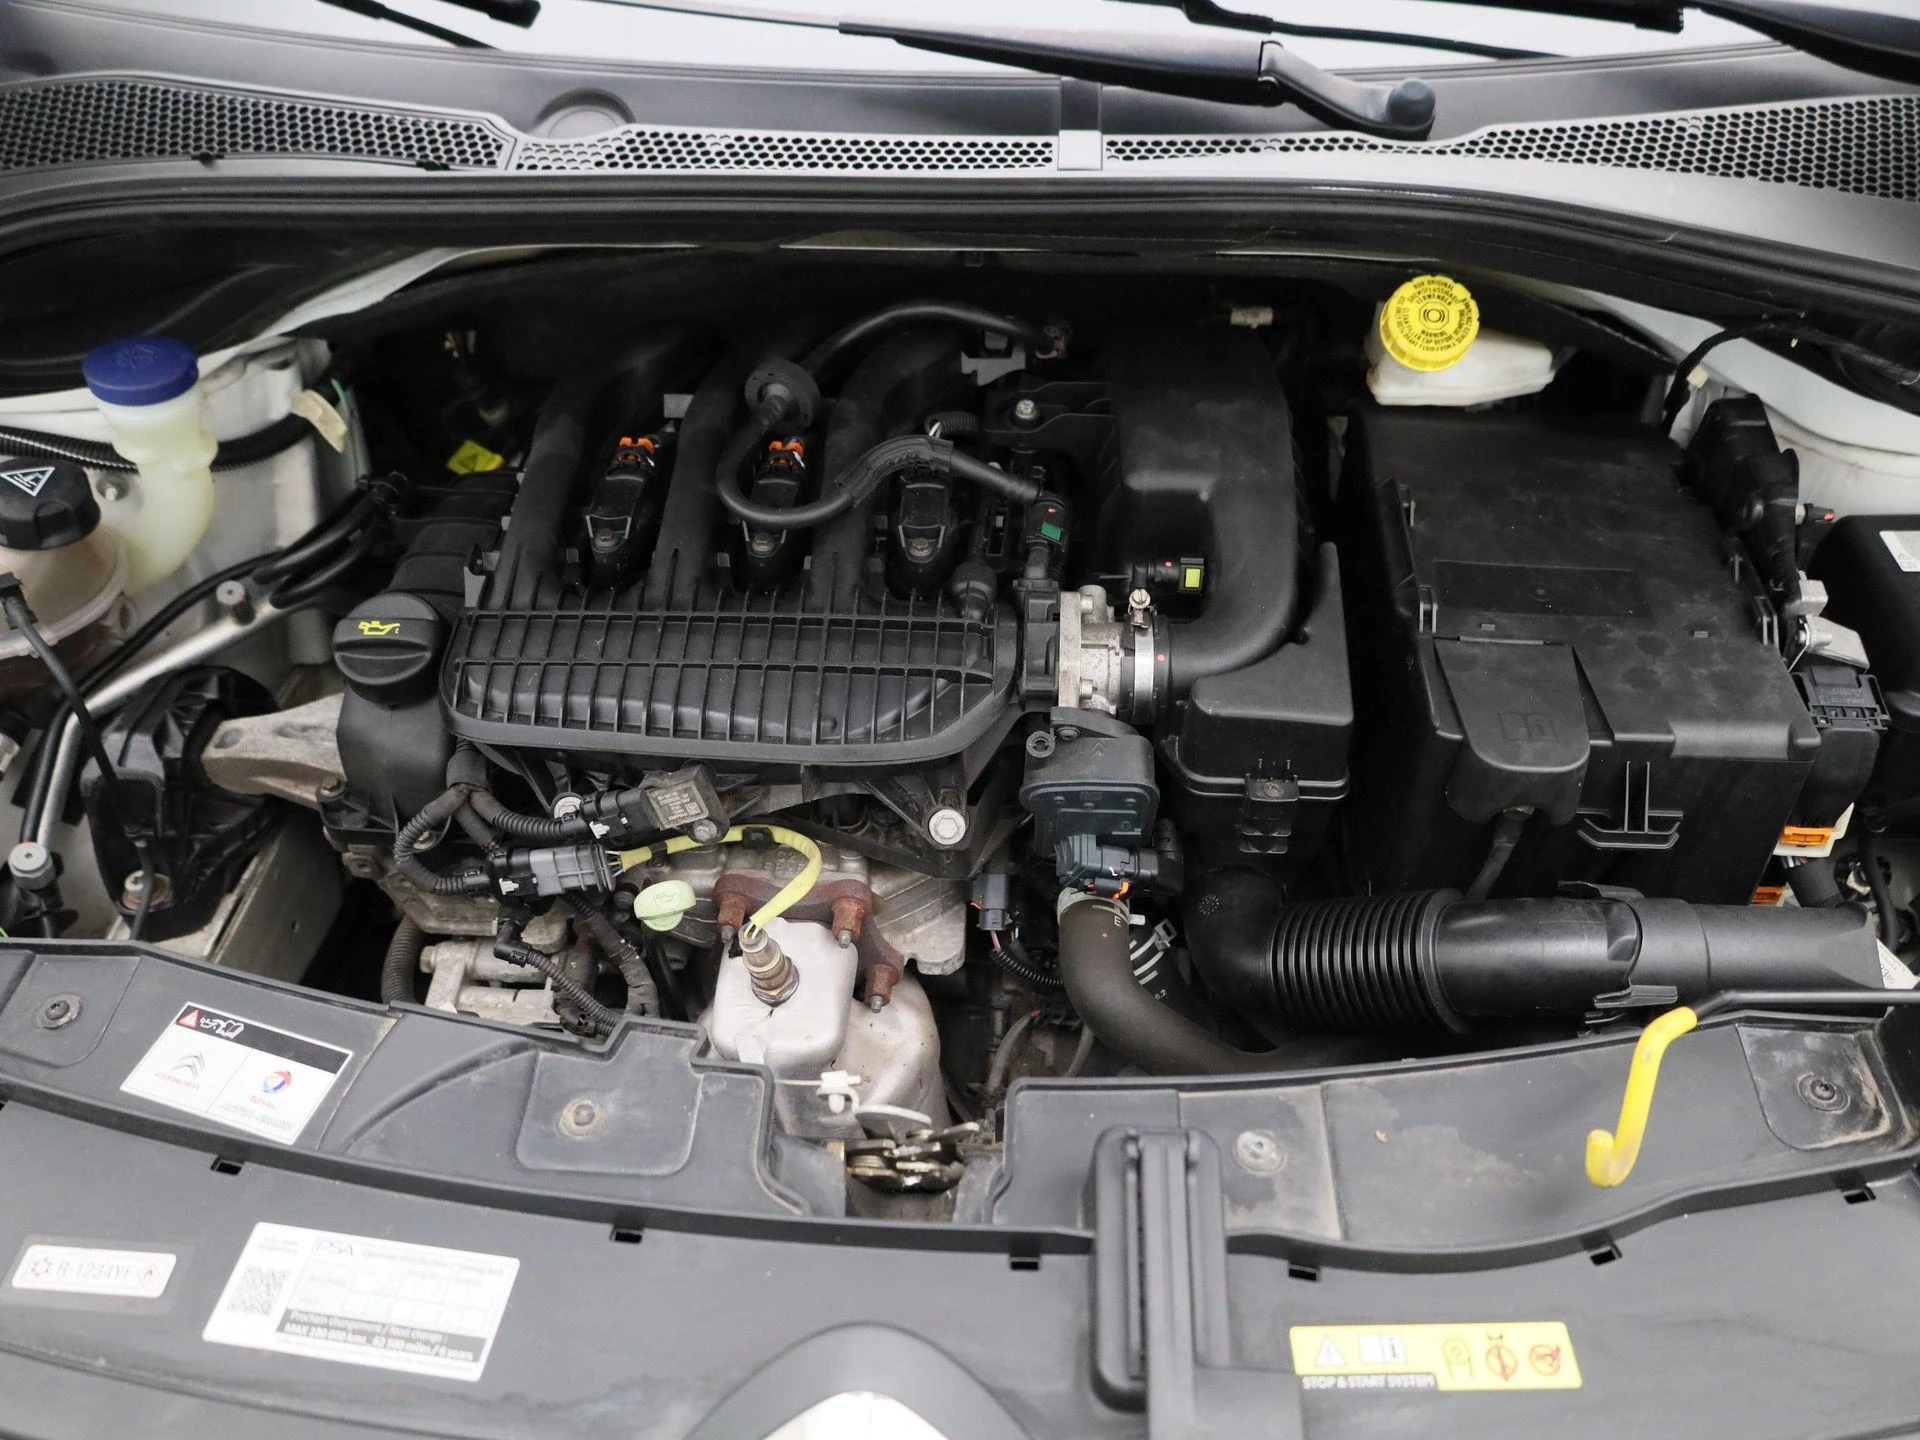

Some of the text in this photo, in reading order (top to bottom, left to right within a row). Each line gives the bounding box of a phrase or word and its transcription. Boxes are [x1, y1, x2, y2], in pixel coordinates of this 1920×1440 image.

[1427, 280, 1454, 291] ORIGINAL
[1402, 307, 1410, 324] CLEAN
[1407, 324, 1421, 340] FILLER
[1422, 337, 1433, 345] CAP
[1434, 334, 1454, 345] BEFORE
[1420, 330, 1447, 338] WARNING
[1403, 333, 1418, 346] BRAKE
[1419, 342, 1436, 352] FLUID
[1436, 344, 1451, 352] FROM
[250, 1095, 277, 1110] TOTAL
[1302, 1374, 1435, 1389] STOP & START SYSTEM
